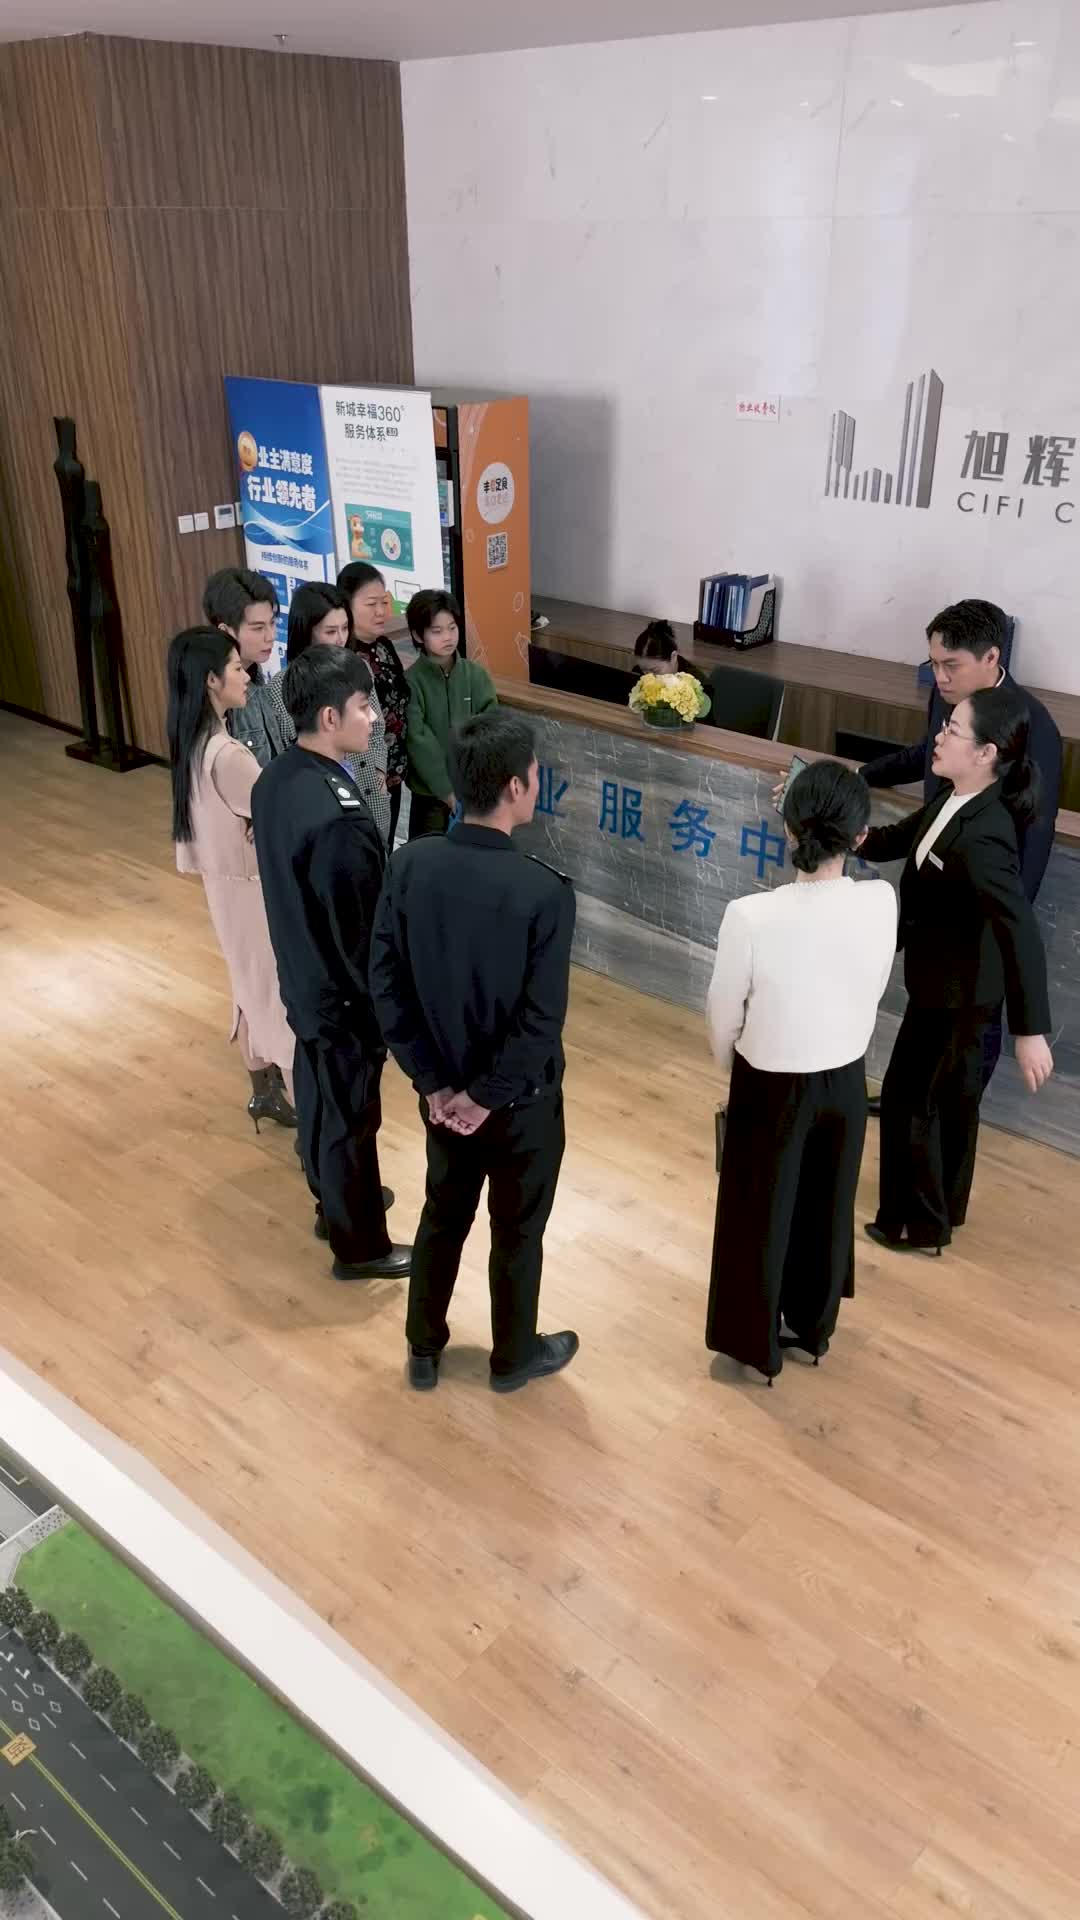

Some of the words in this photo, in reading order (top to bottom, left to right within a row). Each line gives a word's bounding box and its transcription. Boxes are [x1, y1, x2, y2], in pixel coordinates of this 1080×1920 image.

[258, 446, 313, 476] 业主满意度
[960, 429, 1077, 488] 旭辉
[247, 475, 317, 513] 行业领先者
[957, 491, 1025, 519] CIFI
[534, 764, 880, 881] 业服务中
